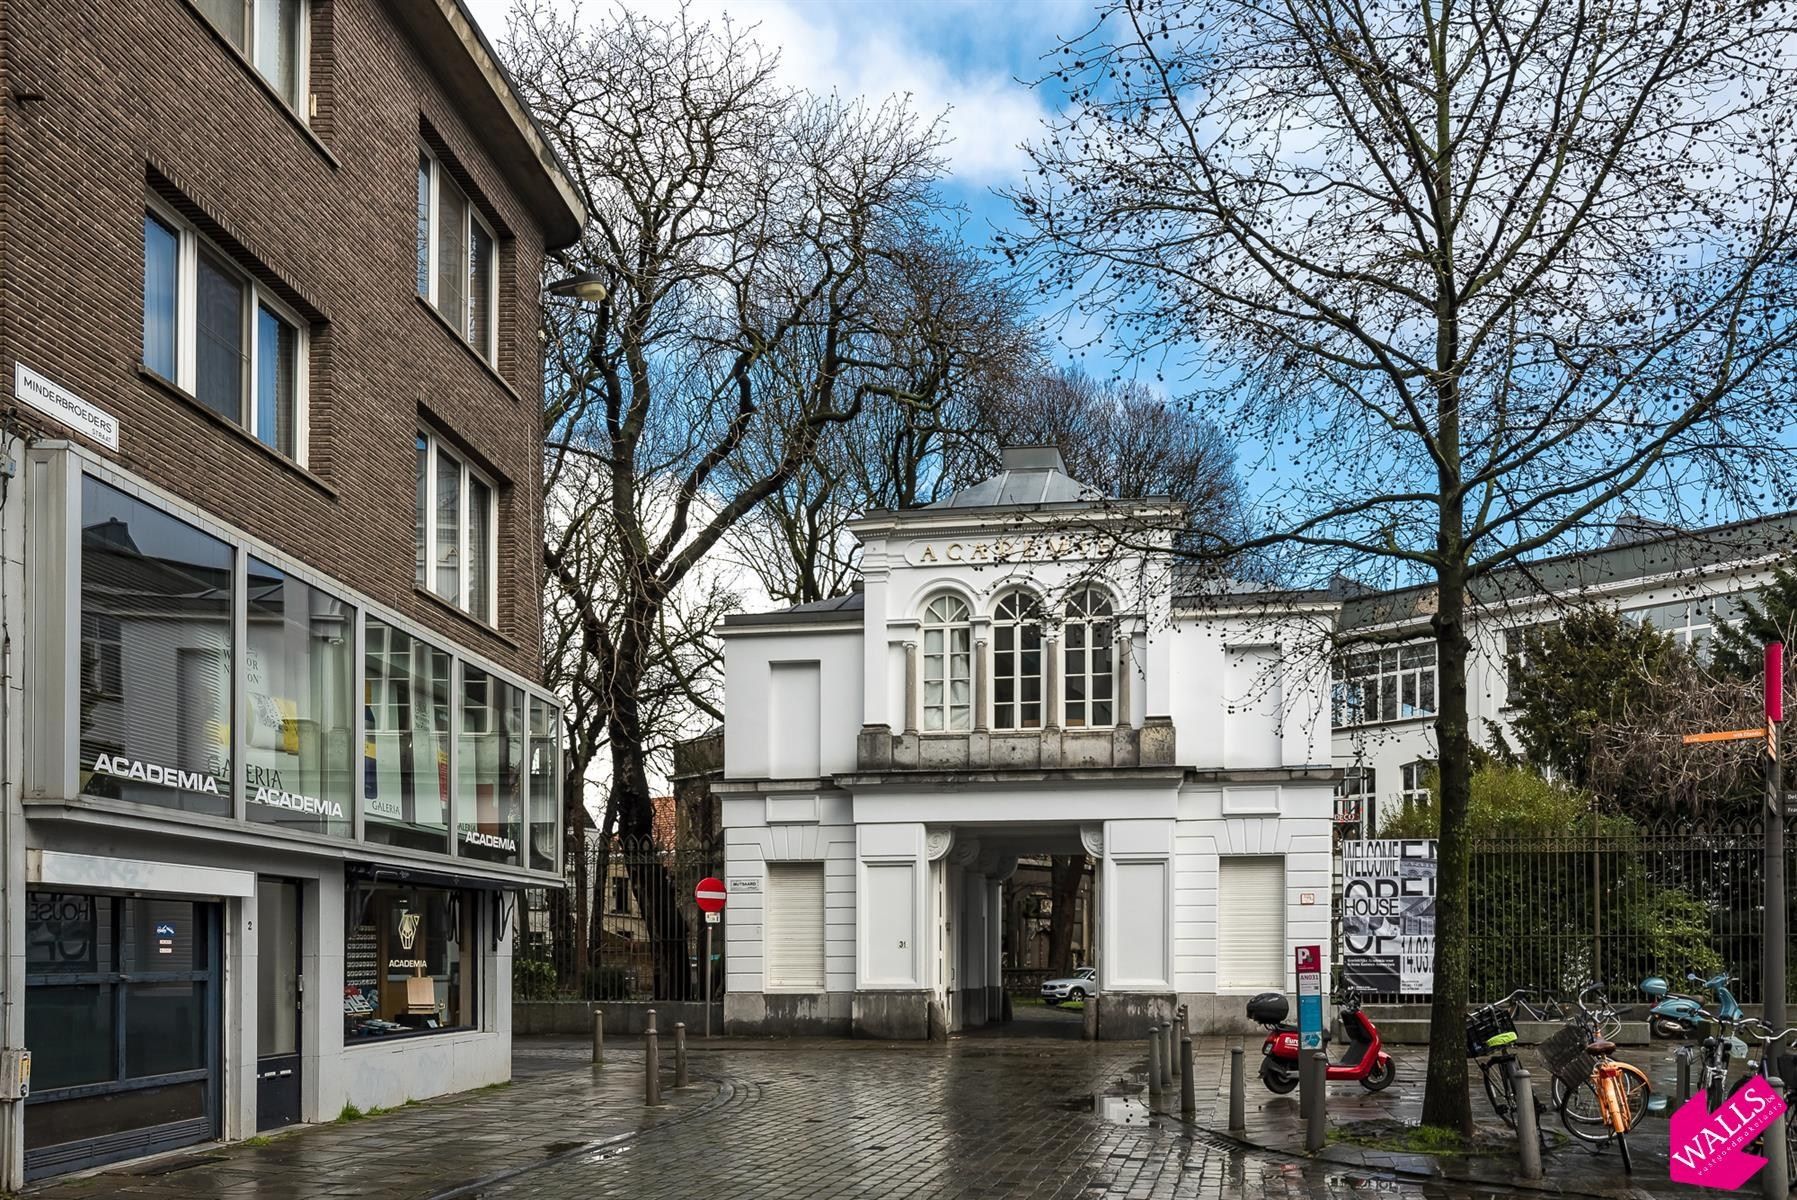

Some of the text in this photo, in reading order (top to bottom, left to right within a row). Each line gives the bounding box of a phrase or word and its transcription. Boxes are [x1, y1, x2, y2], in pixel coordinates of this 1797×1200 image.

[23, 376, 112, 433] MINDERBROEDERS
[91, 427, 112, 442] STRAAT
[94, 753, 219, 794] ACADEMIA
[254, 786, 343, 818] ACADEMIA
[372, 800, 401, 816] GALERIA
[457, 822, 477, 833] ALERIA
[465, 832, 516, 852] ACADEMIA
[1344, 899, 1399, 917] HOUSE
[247, 921, 253, 931] 2
[899, 940, 906, 949] 31
[388, 959, 427, 968] ACADEMIA
